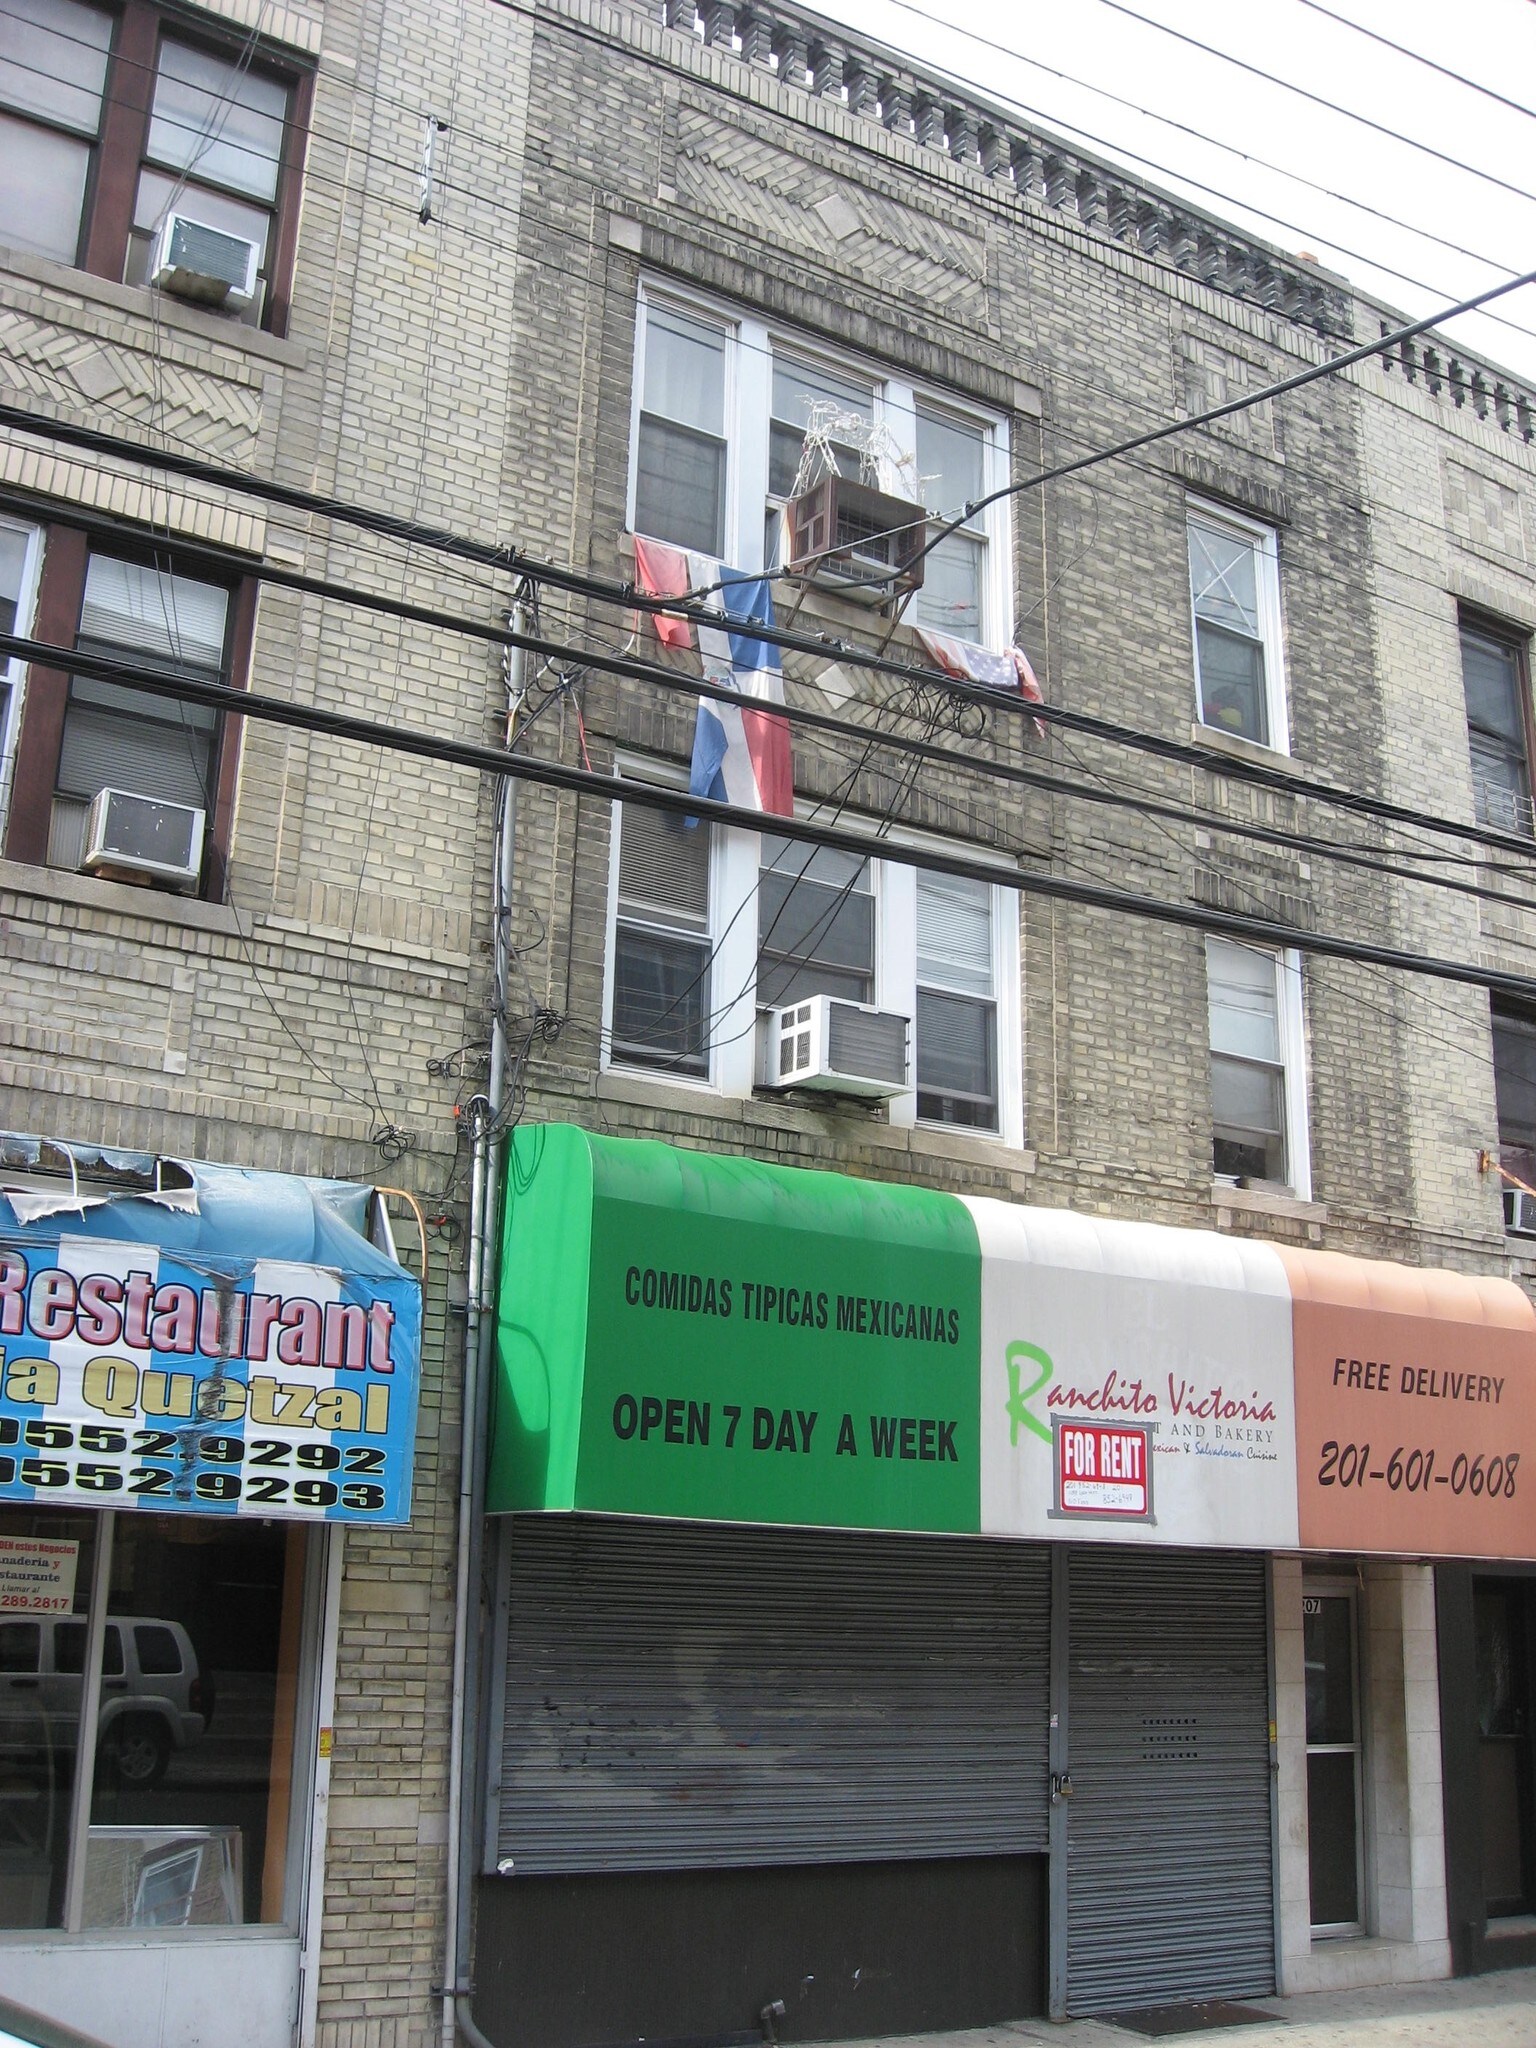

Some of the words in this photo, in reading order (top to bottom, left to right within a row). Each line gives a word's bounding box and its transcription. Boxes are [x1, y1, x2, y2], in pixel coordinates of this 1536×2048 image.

[0, 1249, 394, 1373] Restaurant
[625, 1266, 733, 1318] COMIDAS
[742, 1282, 828, 1330] TIPICAS
[837, 1295, 959, 1345] MEXICANAS
[0, 1346, 60, 1405] a
[82, 1355, 391, 1434] Quetzal
[1005, 1340, 1158, 1447] Ranchito
[1168, 1372, 1277, 1422] Victoria
[1332, 1358, 1391, 1392] FREE
[1401, 1366, 1505, 1403] DELIVERY
[613, 1393, 710, 1447] OPEN
[723, 1405, 742, 1448] 7
[753, 1406, 818, 1454] DAY
[836, 1413, 858, 1456] A
[870, 1416, 959, 1462] WEEK
[1064, 1431, 1096, 1476] FOR
[1100, 1434, 1142, 1480] RENT
[1171, 1423, 1206, 1437] AND
[1215, 1425, 1273, 1442] BAKERY
[1183, 1442, 1191, 1454] &
[1195, 1441, 1244, 1457] Salvadoran
[1247, 1446, 1278, 1460] Cuisine
[1318, 1440, 1521, 1498] 201-601-0608
[53, 1560, 61, 1570] y
